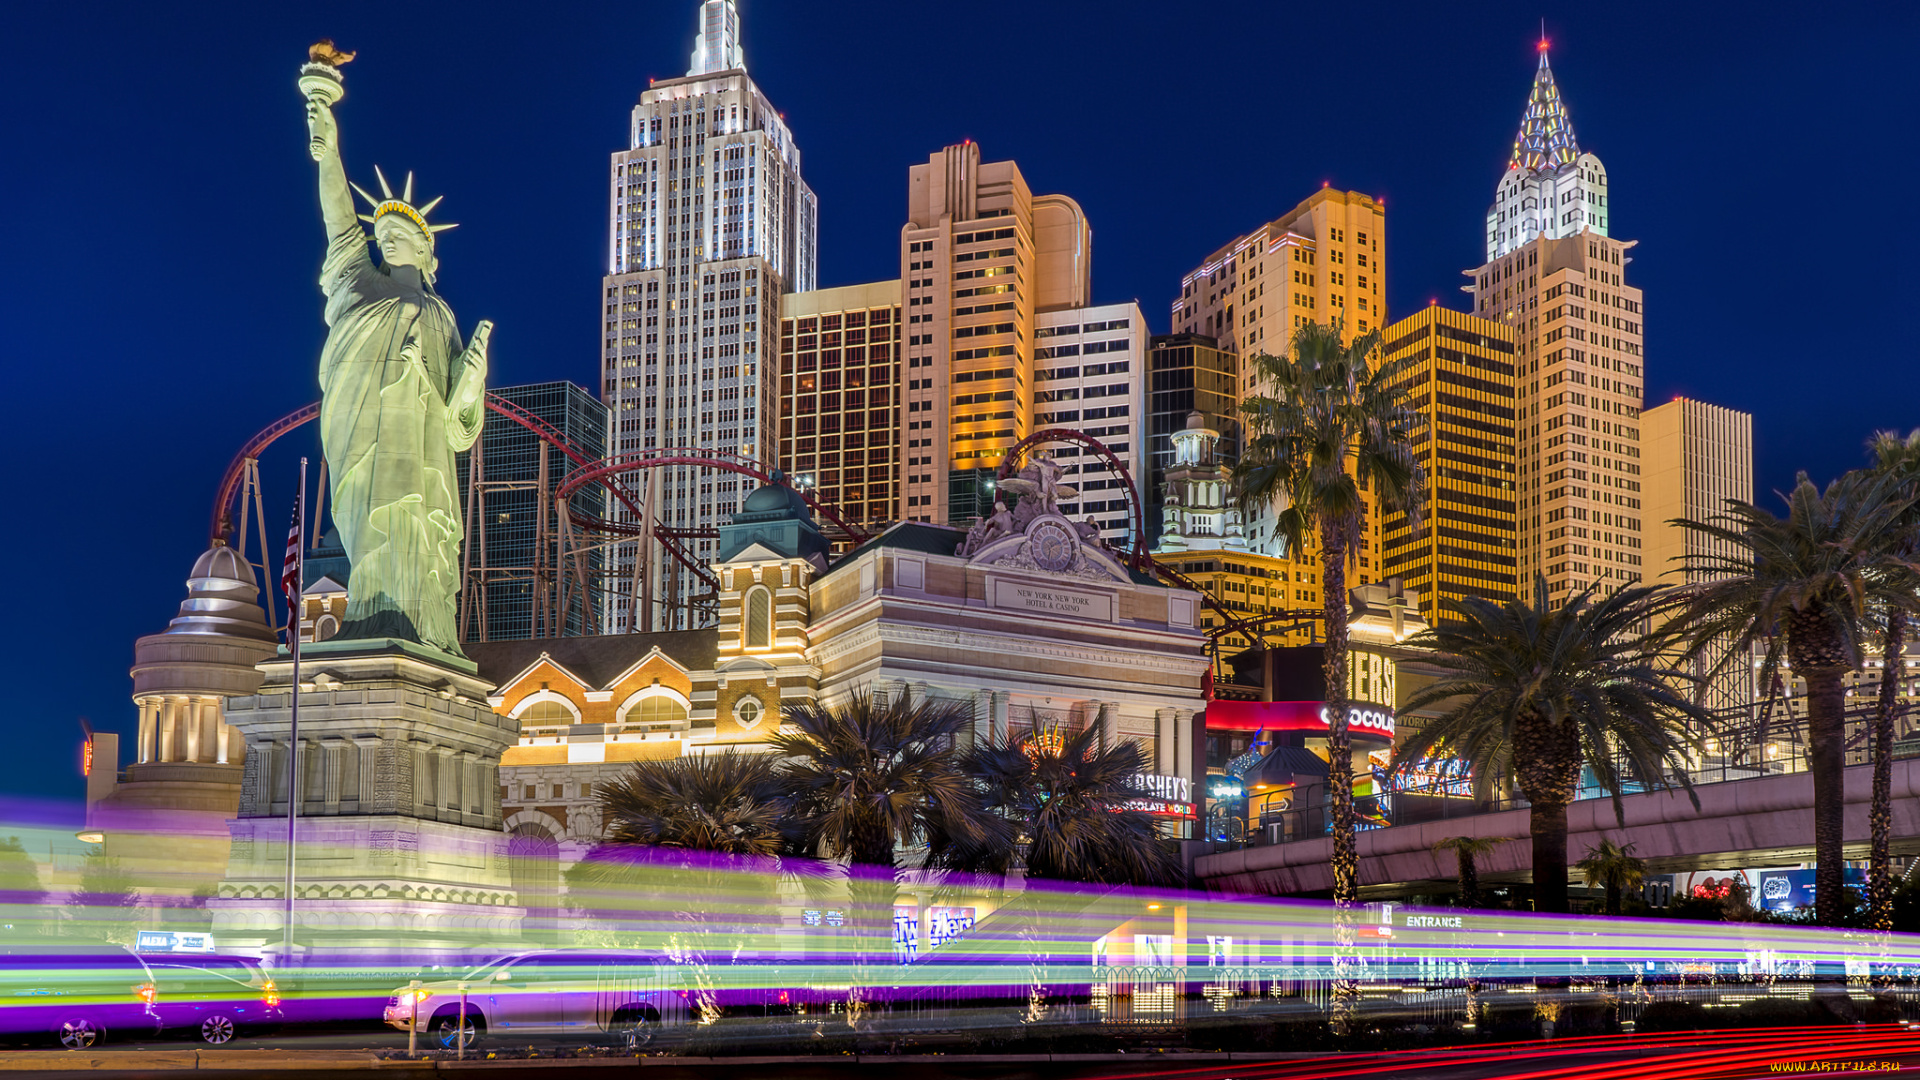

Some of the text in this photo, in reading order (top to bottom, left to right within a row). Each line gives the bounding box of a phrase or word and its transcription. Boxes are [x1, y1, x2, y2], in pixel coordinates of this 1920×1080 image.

[1017, 589, 1090, 606] NEW YORK NEW YORK
[1026, 599, 1047, 609] HOTEL
[1055, 603, 1080, 613] CASINO
[1167, 803, 1192, 815] WORLD
[1406, 916, 1462, 928] ENTRANCE
